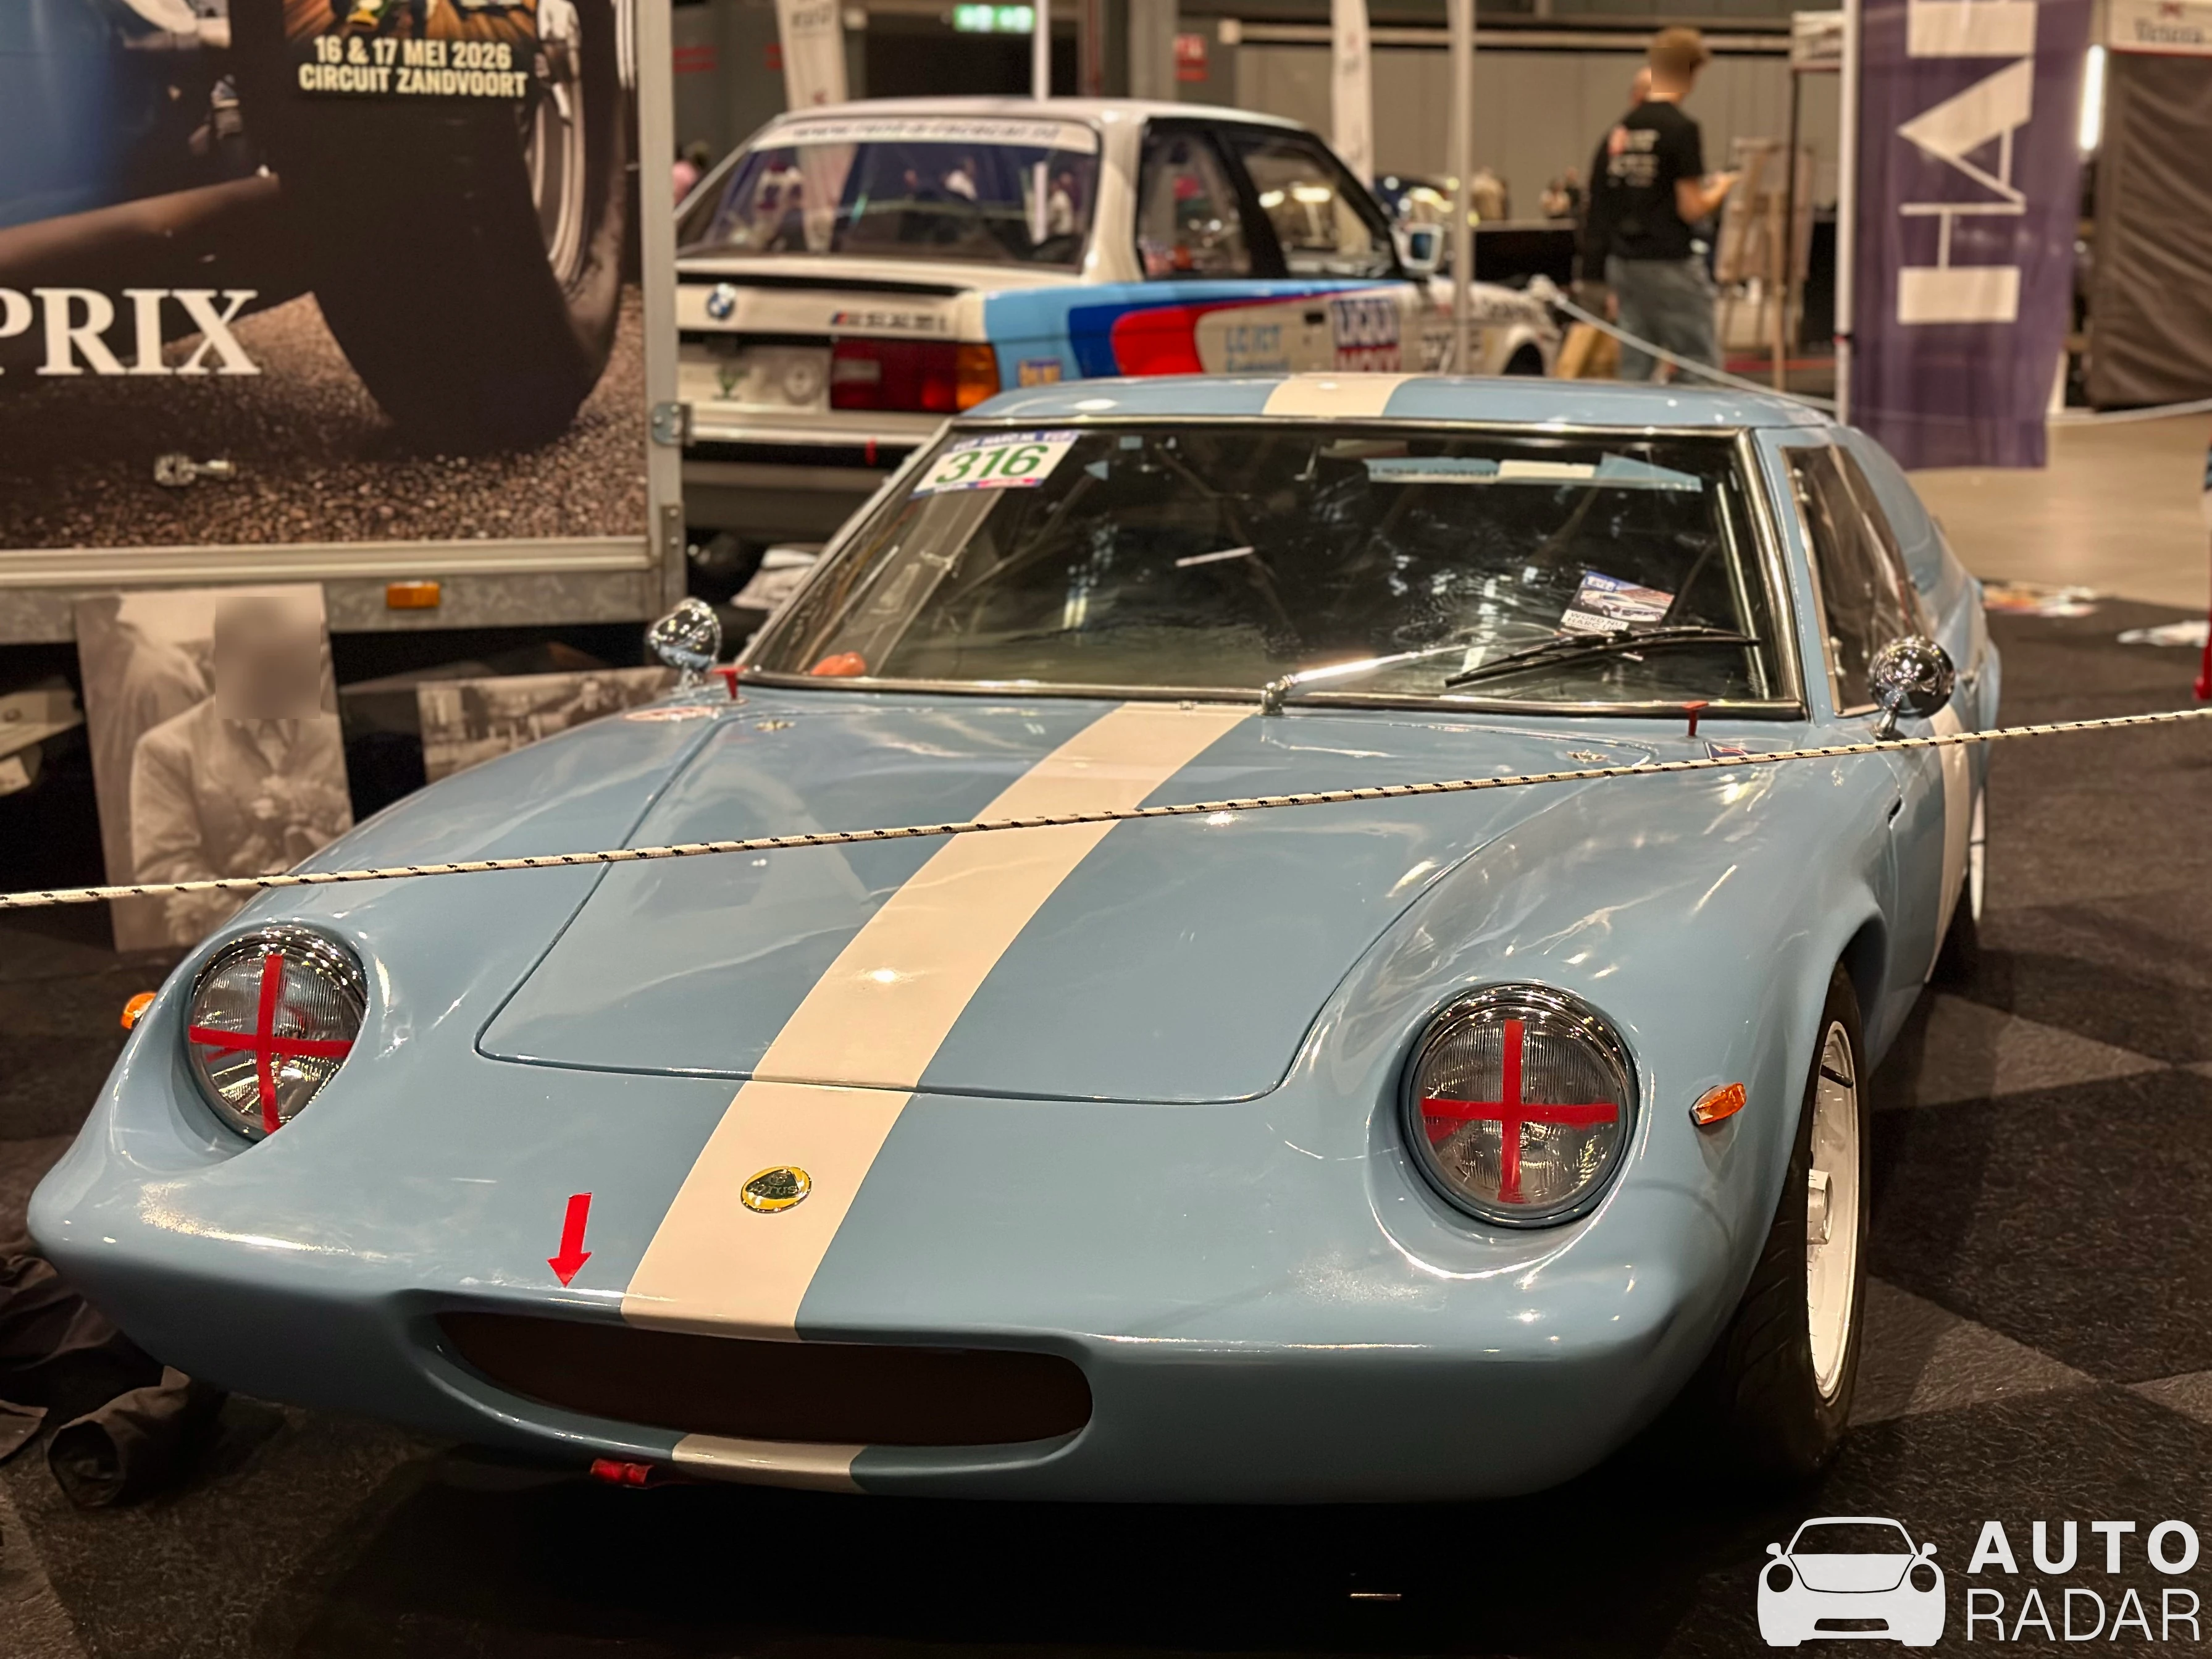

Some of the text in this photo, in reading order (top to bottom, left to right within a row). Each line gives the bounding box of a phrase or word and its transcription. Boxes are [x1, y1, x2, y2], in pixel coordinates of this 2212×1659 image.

[314, 35, 512, 70] 16 & 17 MEI 2026
[298, 63, 528, 98] CIRCUIT ZANDVOORT
[935, 445, 1049, 483] 316
[1567, 618, 1599, 628] HARC
[1571, 612, 1604, 623] WORD
